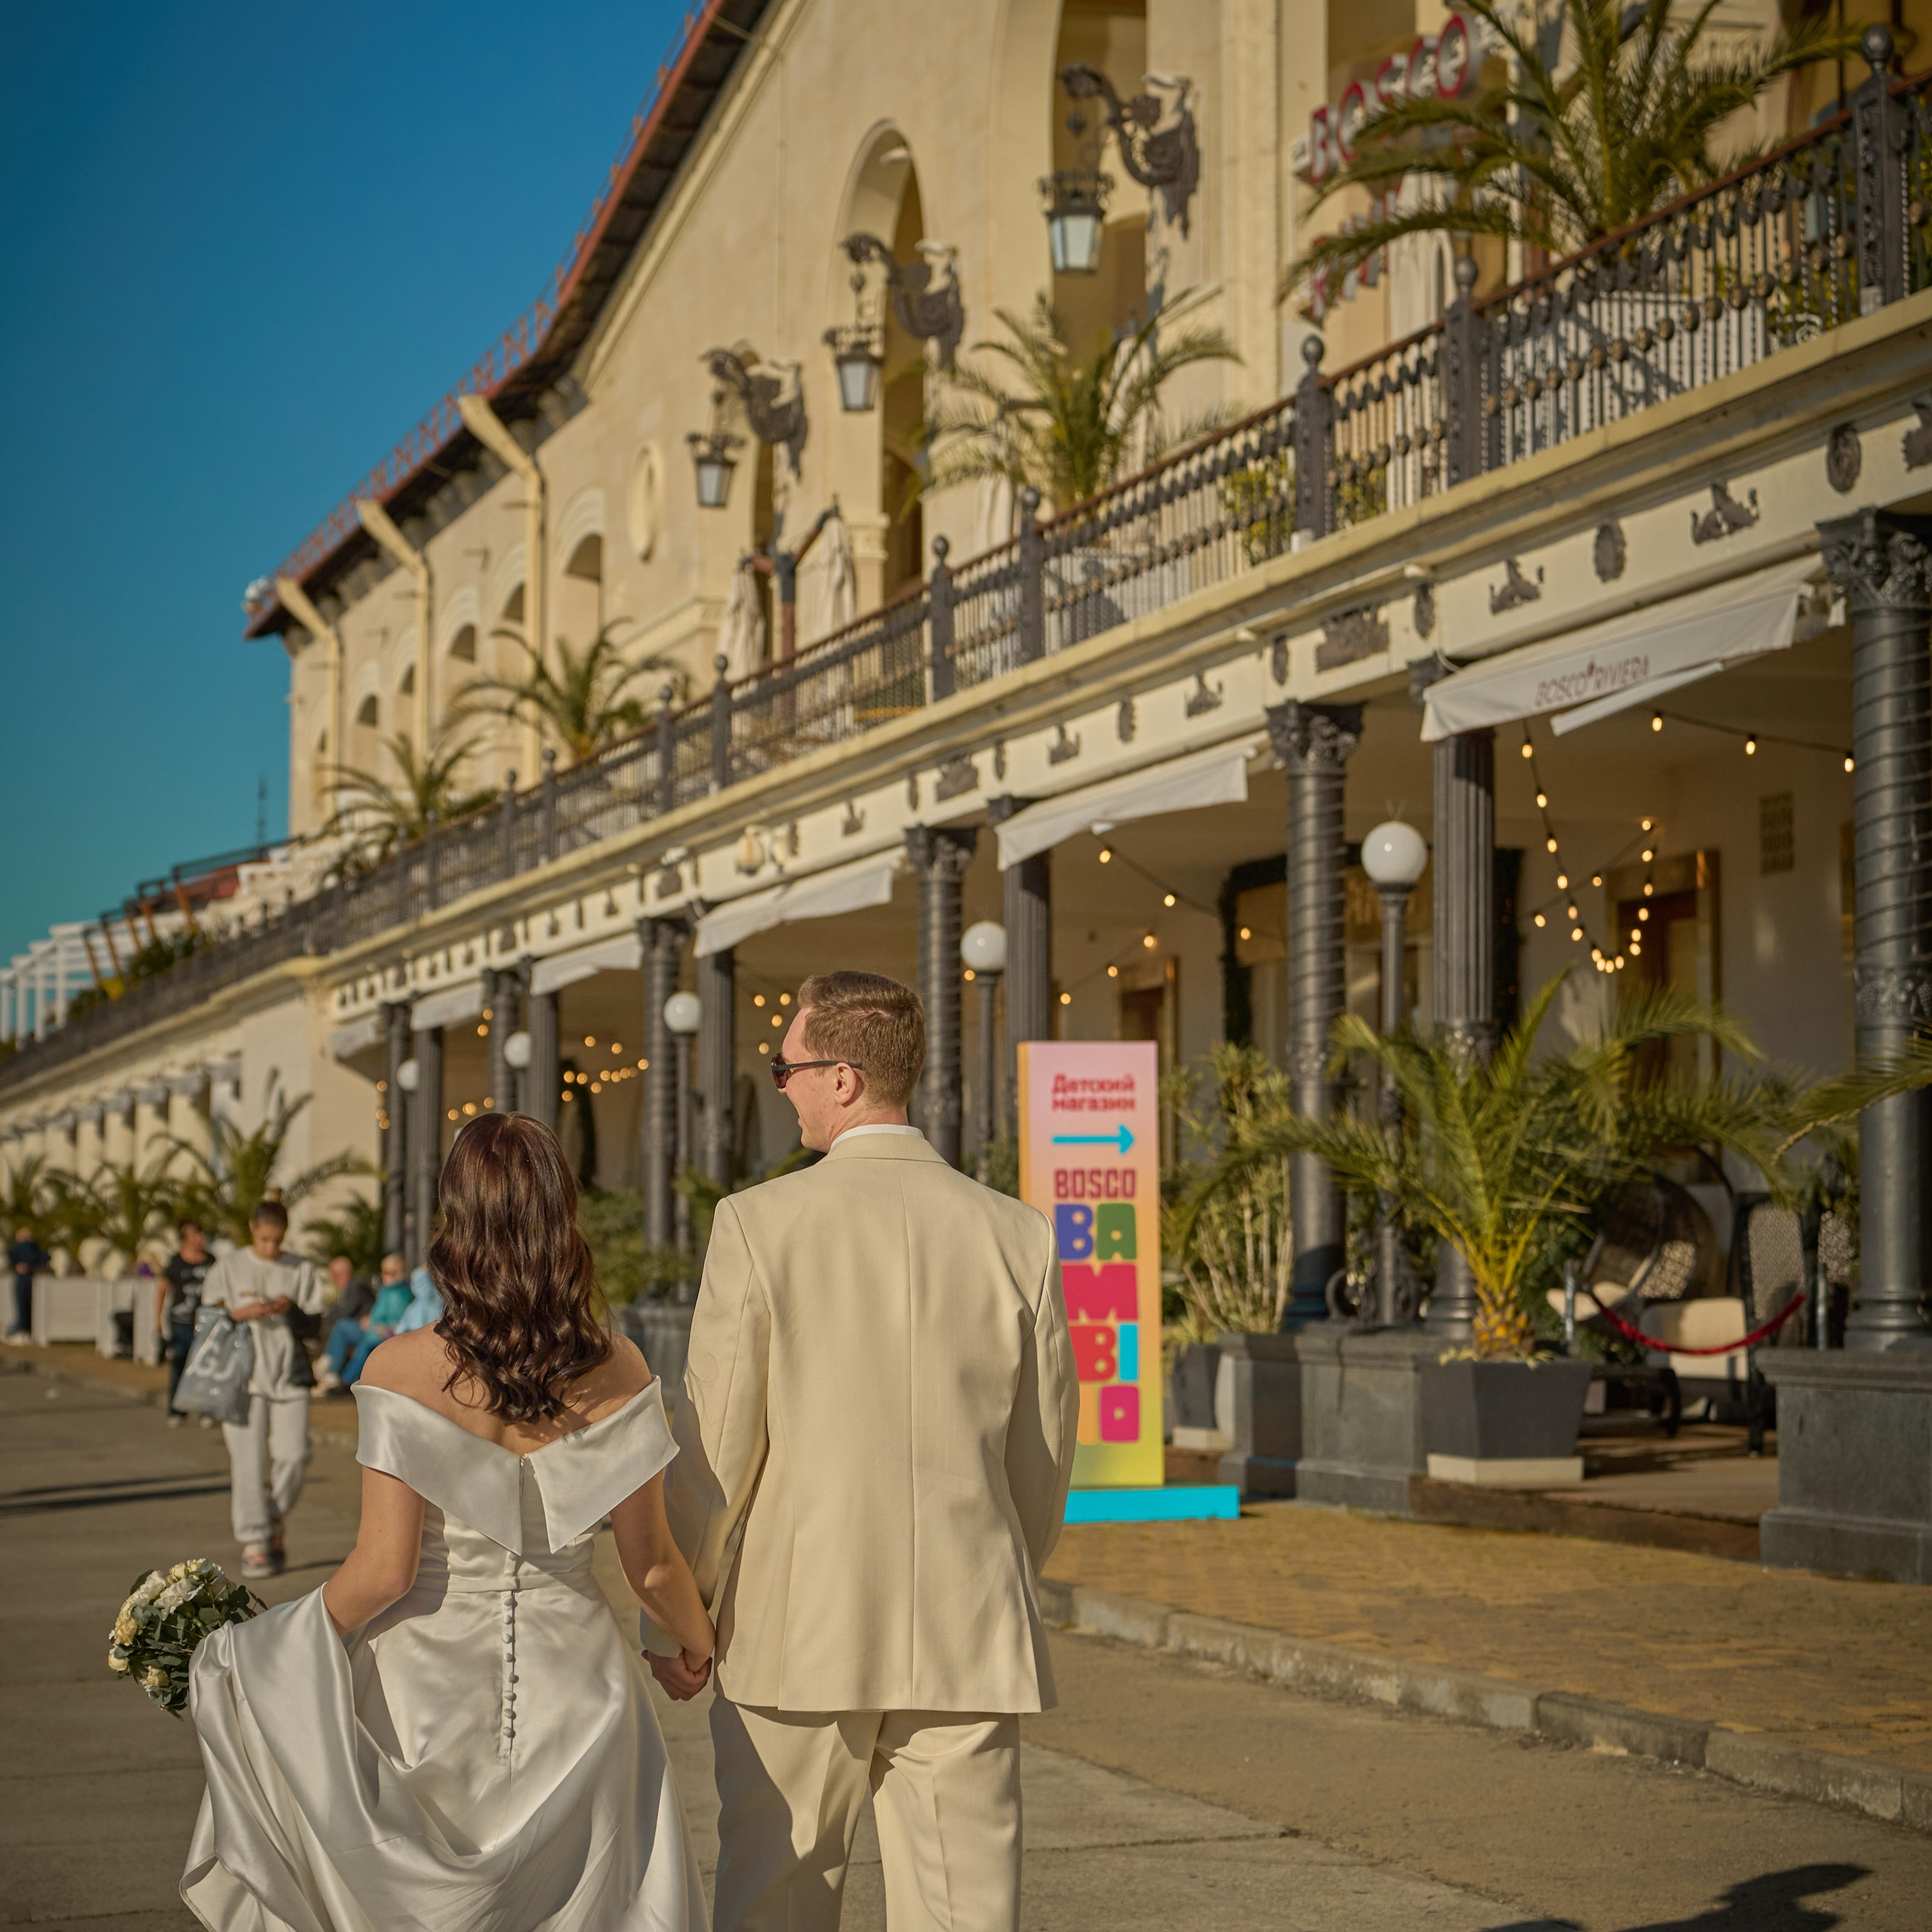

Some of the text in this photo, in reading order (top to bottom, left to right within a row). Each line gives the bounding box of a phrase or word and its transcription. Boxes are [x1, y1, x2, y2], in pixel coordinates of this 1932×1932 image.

[1052, 1073, 1135, 1094] Детский
[1052, 1097, 1136, 1112] магазин
[1054, 1169, 1137, 1199] BOSCO
